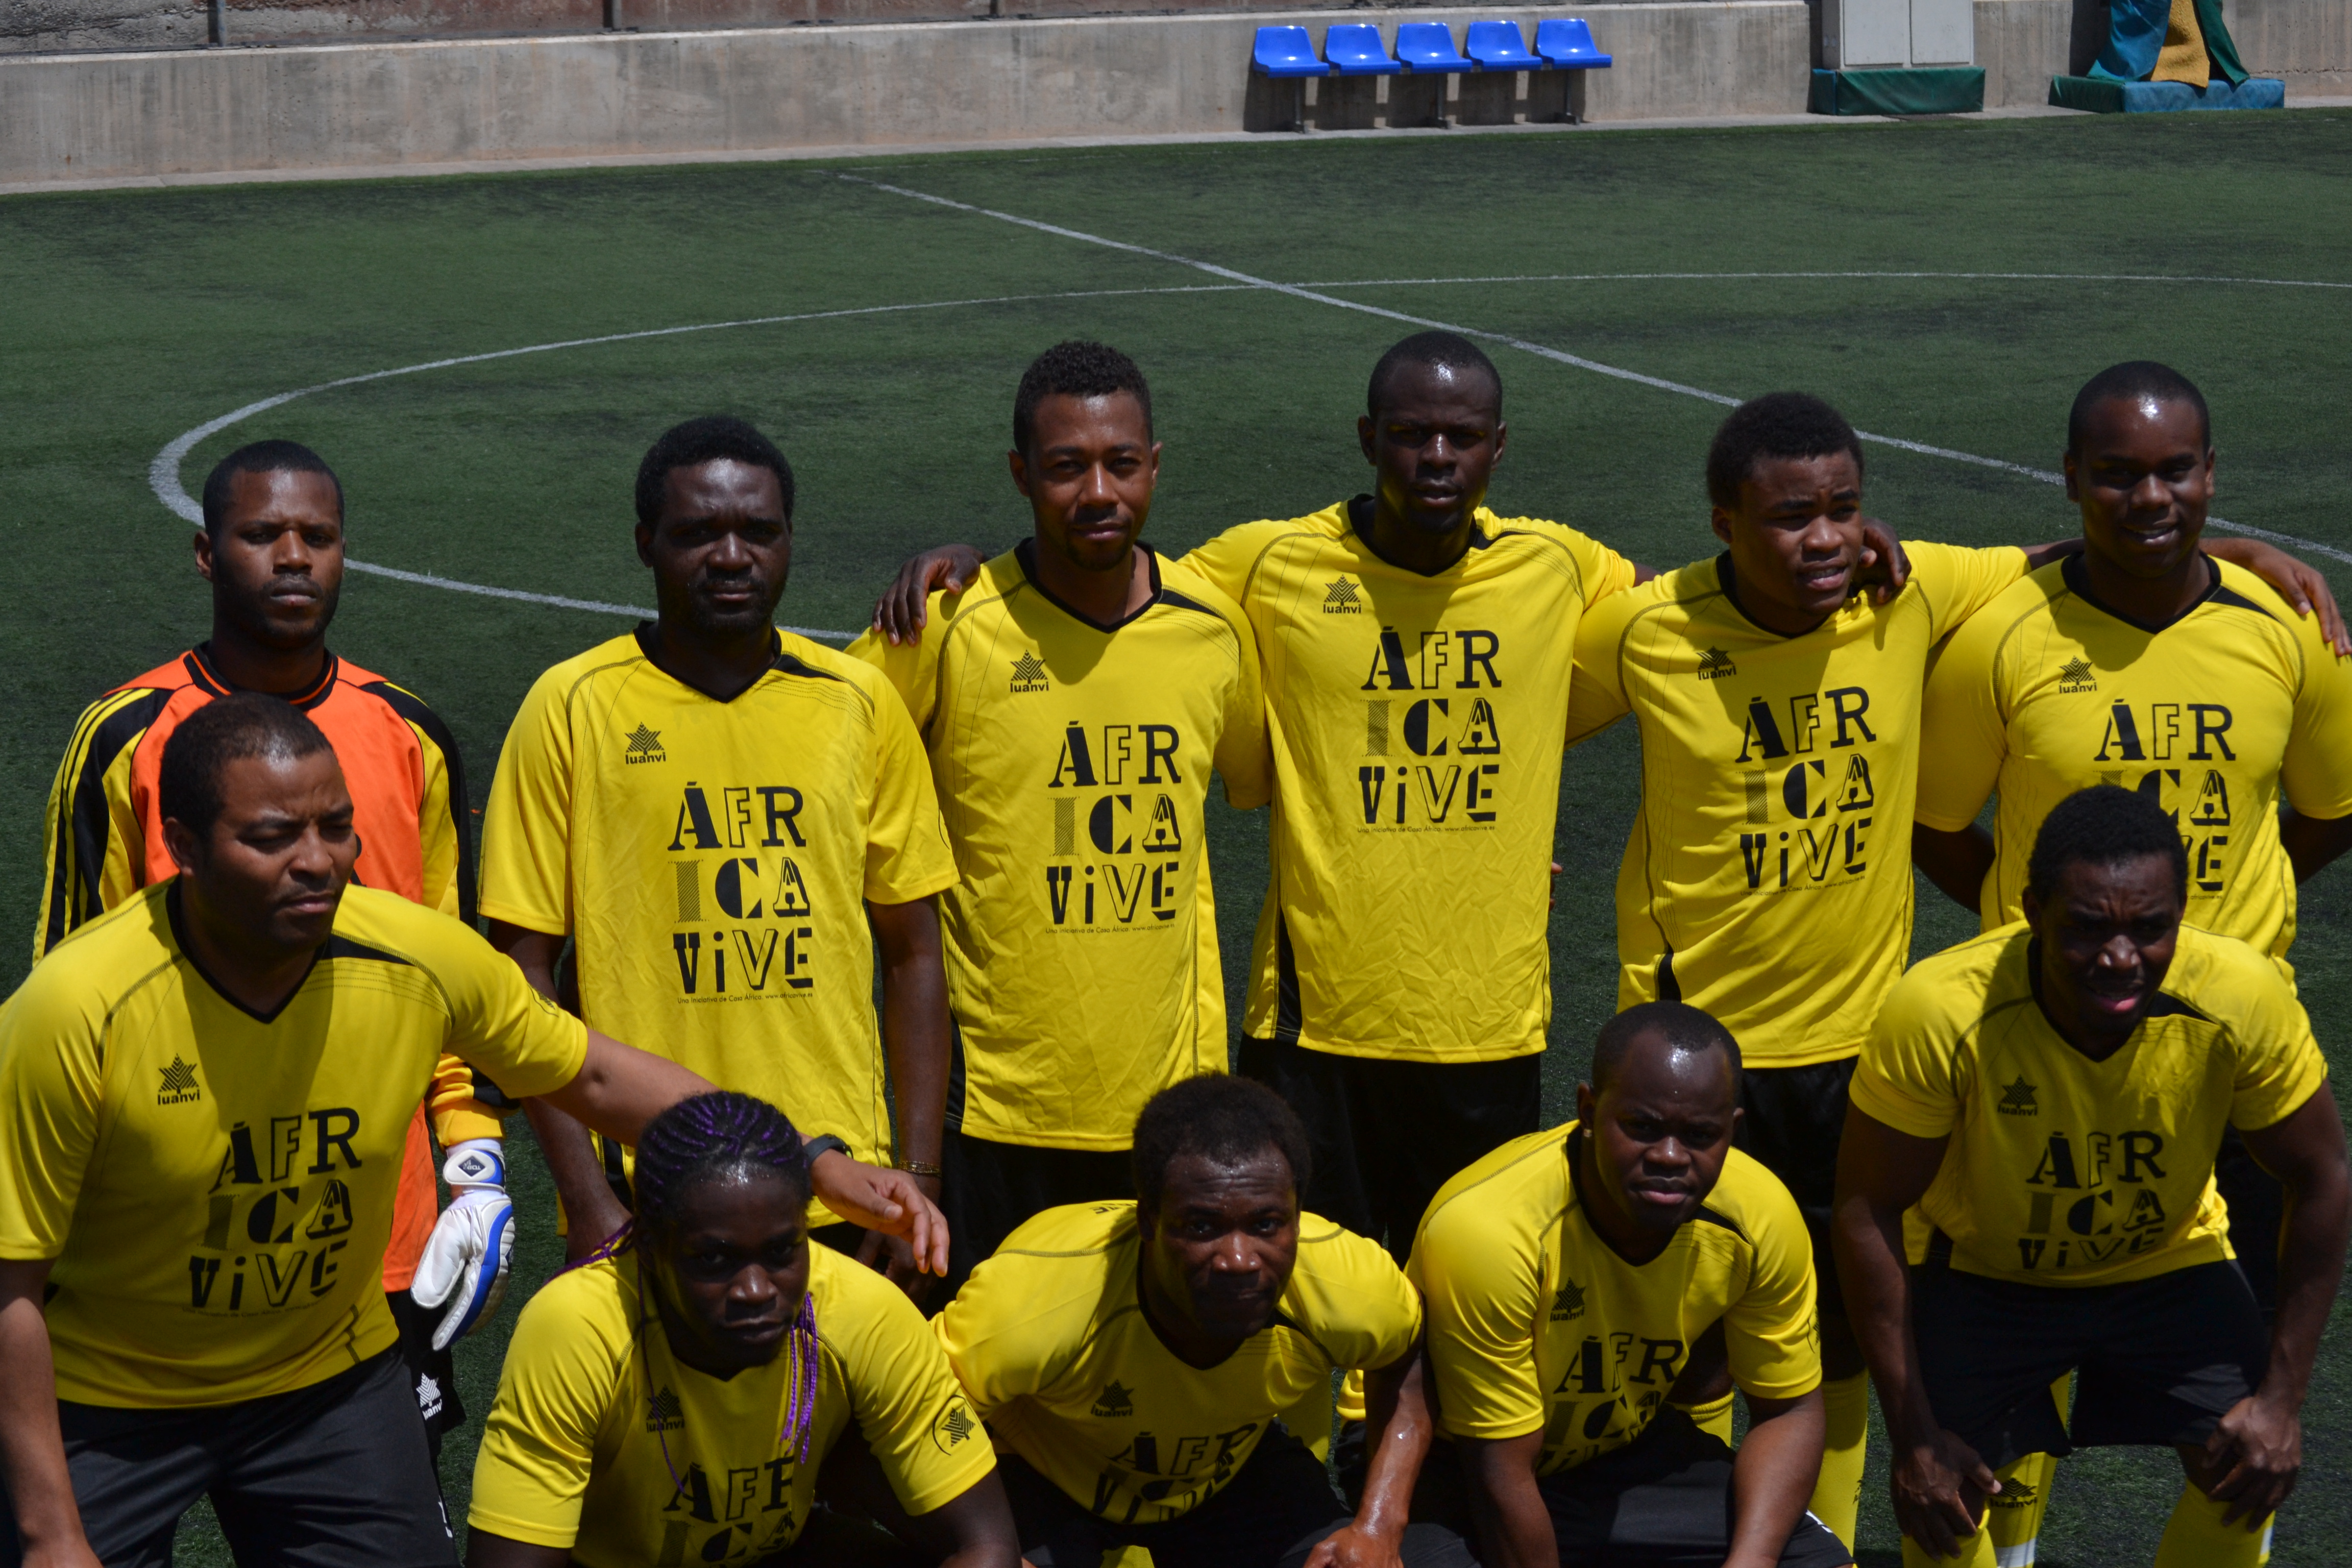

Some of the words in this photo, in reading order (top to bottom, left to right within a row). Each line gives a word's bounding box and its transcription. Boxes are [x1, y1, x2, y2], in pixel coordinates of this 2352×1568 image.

[1323, 603, 1361, 614] luanvi
[1360, 626, 1502, 690] ÁFR
[1697, 665, 1736, 680] luanvi
[1010, 681, 1049, 693] luanvi
[2059, 682, 2097, 694] luanvi
[1360, 697, 1501, 756] ICA
[1735, 686, 1876, 763] ÁFR
[2093, 698, 2236, 762] ÁFR
[625, 751, 667, 765] luanvi
[1047, 721, 1182, 788] ÁFR
[1735, 753, 1874, 825] ICA
[2093, 769, 2231, 826] CA
[667, 781, 806, 851] ÁFR
[1047, 793, 1182, 857] ICA
[668, 856, 812, 923] ICA
[157, 1090, 201, 1106] luanvi
[1997, 1104, 2038, 1116] luanvi
[196, 1179, 353, 1252] ICA
[2024, 1189, 2165, 1236] ICA
[1550, 1306, 1585, 1322] luanvi
[646, 1418, 685, 1434] luanvi
[1090, 1404, 1133, 1417] luanvi
